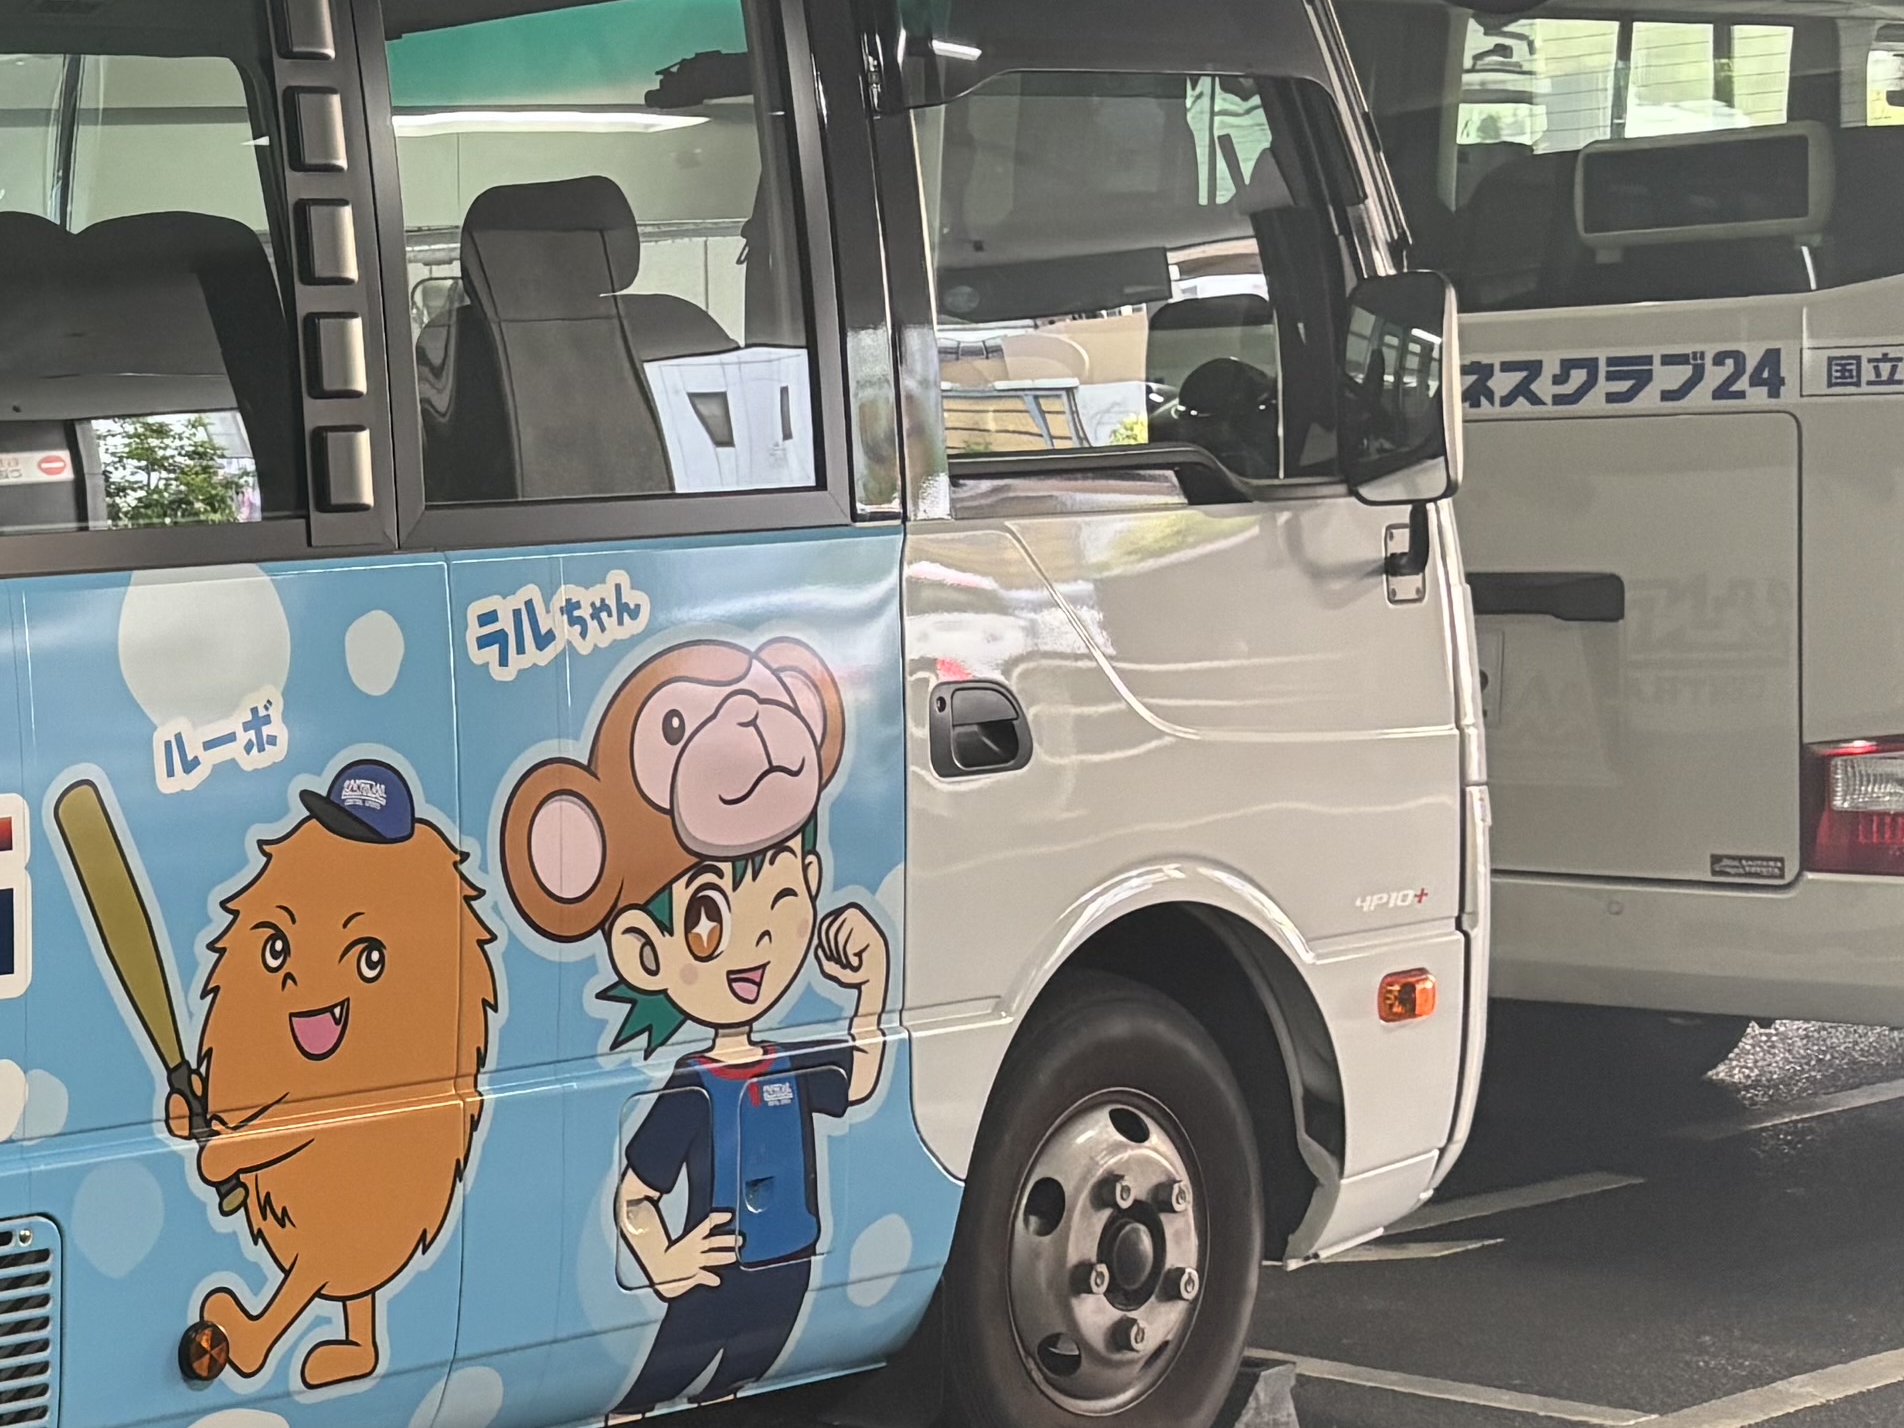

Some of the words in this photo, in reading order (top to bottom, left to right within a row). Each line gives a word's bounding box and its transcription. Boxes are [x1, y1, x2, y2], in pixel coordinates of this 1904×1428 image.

[1461, 347, 1787, 409] ネスクラブ24
[475, 582, 642, 668] ラルちゃん
[163, 698, 279, 779] ルーボ
